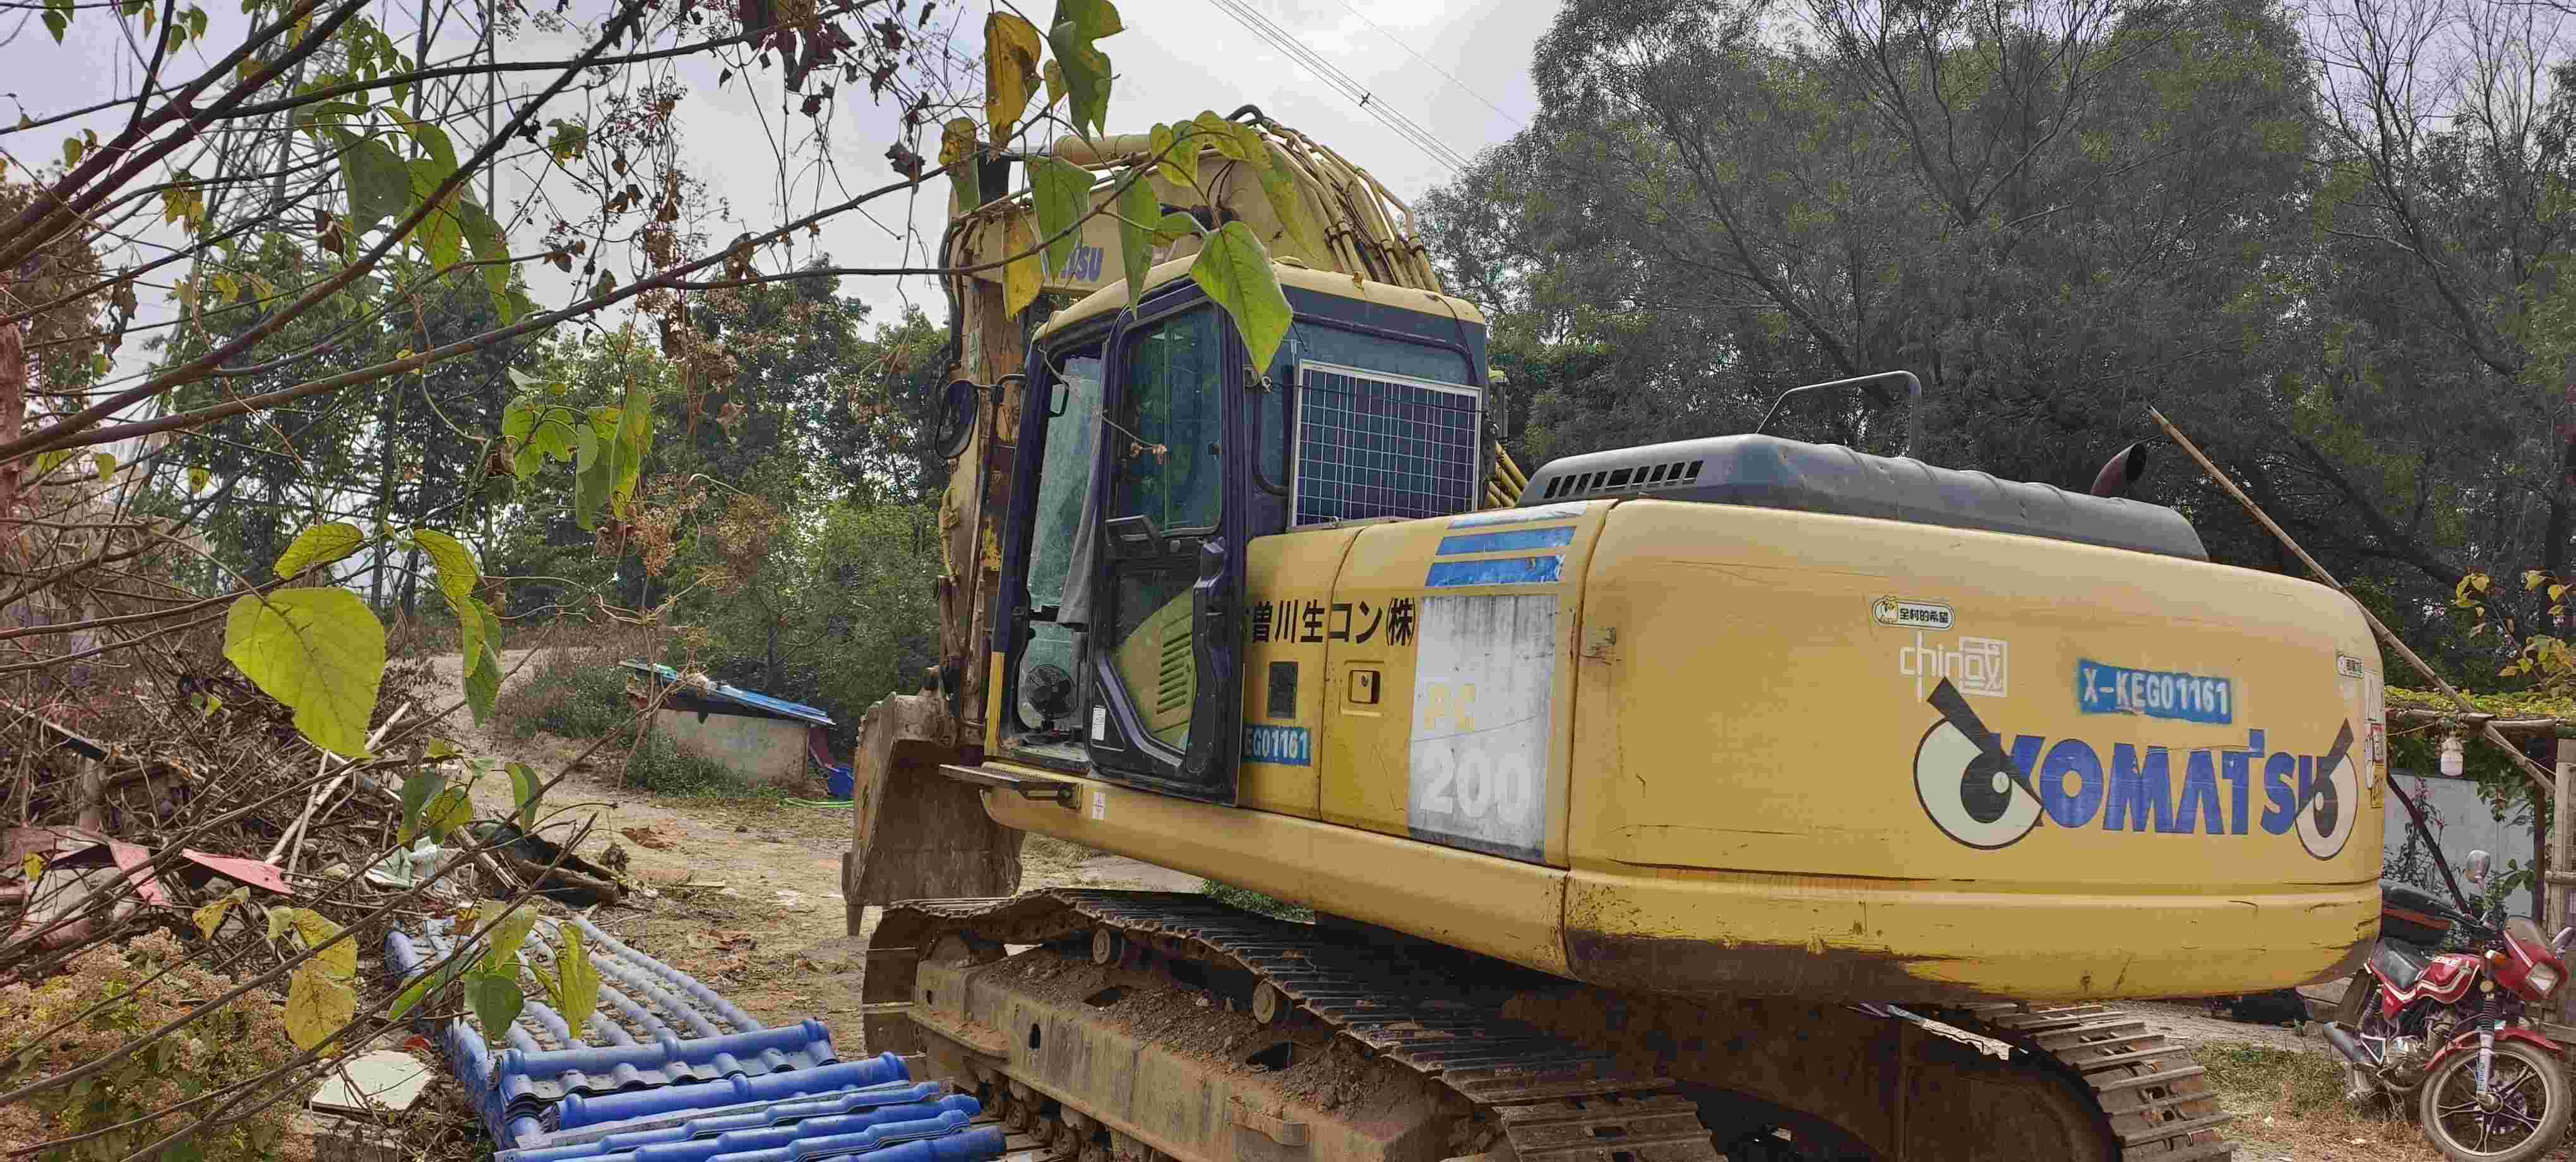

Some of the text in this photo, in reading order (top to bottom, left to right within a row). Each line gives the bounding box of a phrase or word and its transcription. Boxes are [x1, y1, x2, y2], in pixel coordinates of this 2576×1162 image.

[1899, 608, 1949, 623] 全村的希望
[1419, 738, 1532, 825] 200
